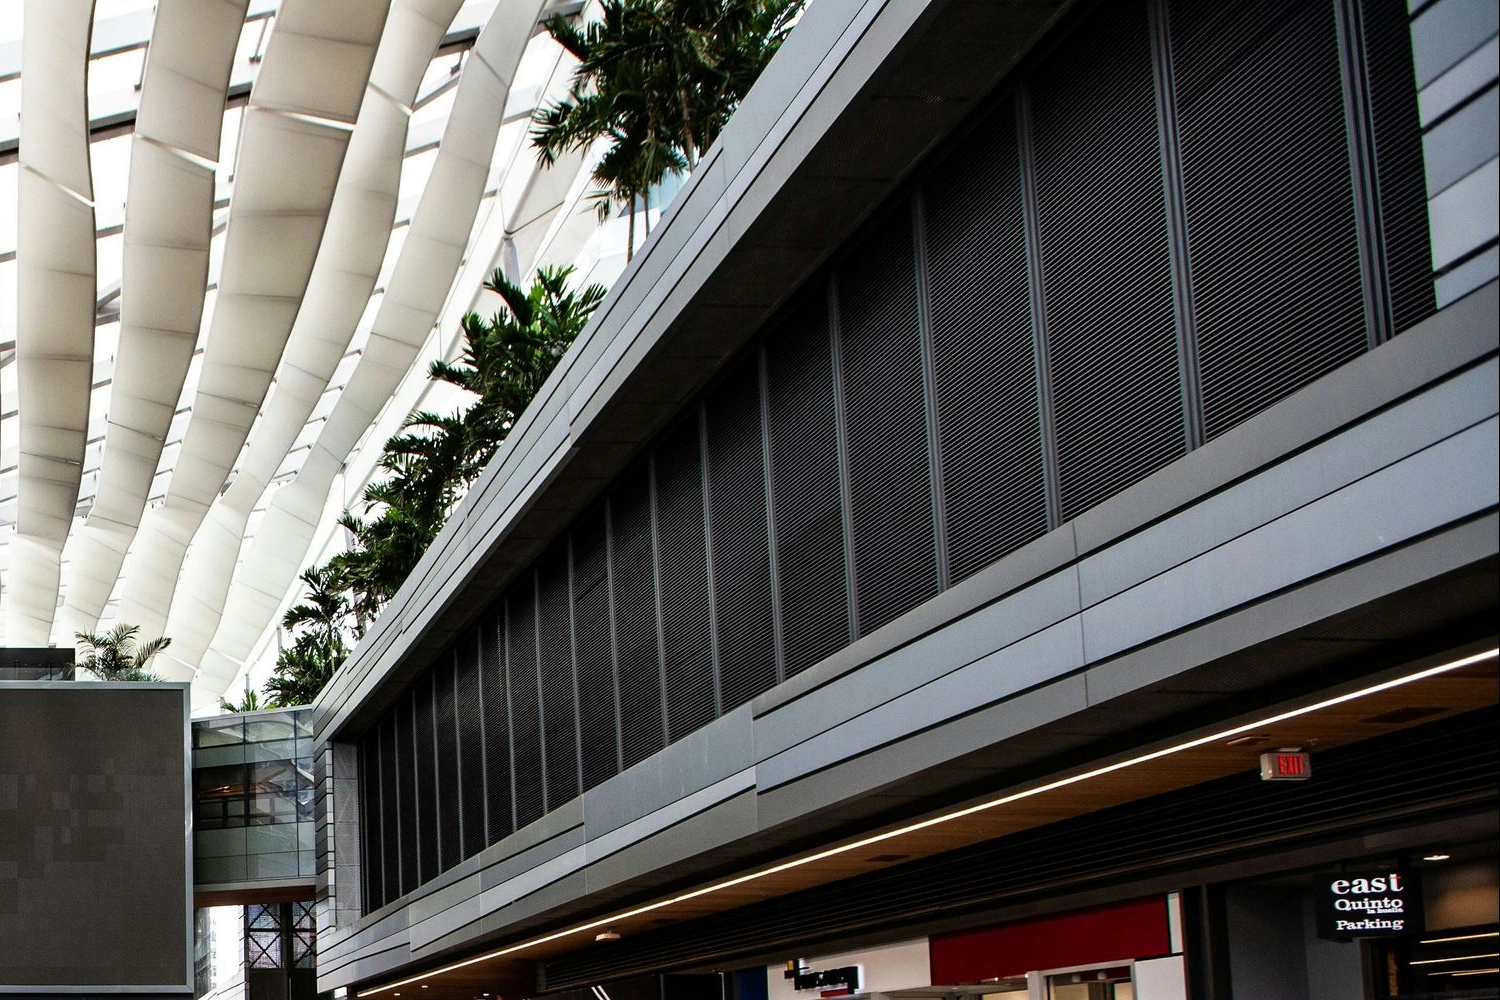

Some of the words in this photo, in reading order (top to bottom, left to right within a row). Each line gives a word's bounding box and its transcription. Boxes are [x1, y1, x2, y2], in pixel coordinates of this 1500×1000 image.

[1277, 754, 1304, 775] EXIT
[1330, 873, 1404, 895] east
[1334, 897, 1404, 912] Quinto
[1335, 918, 1405, 931] Parking
